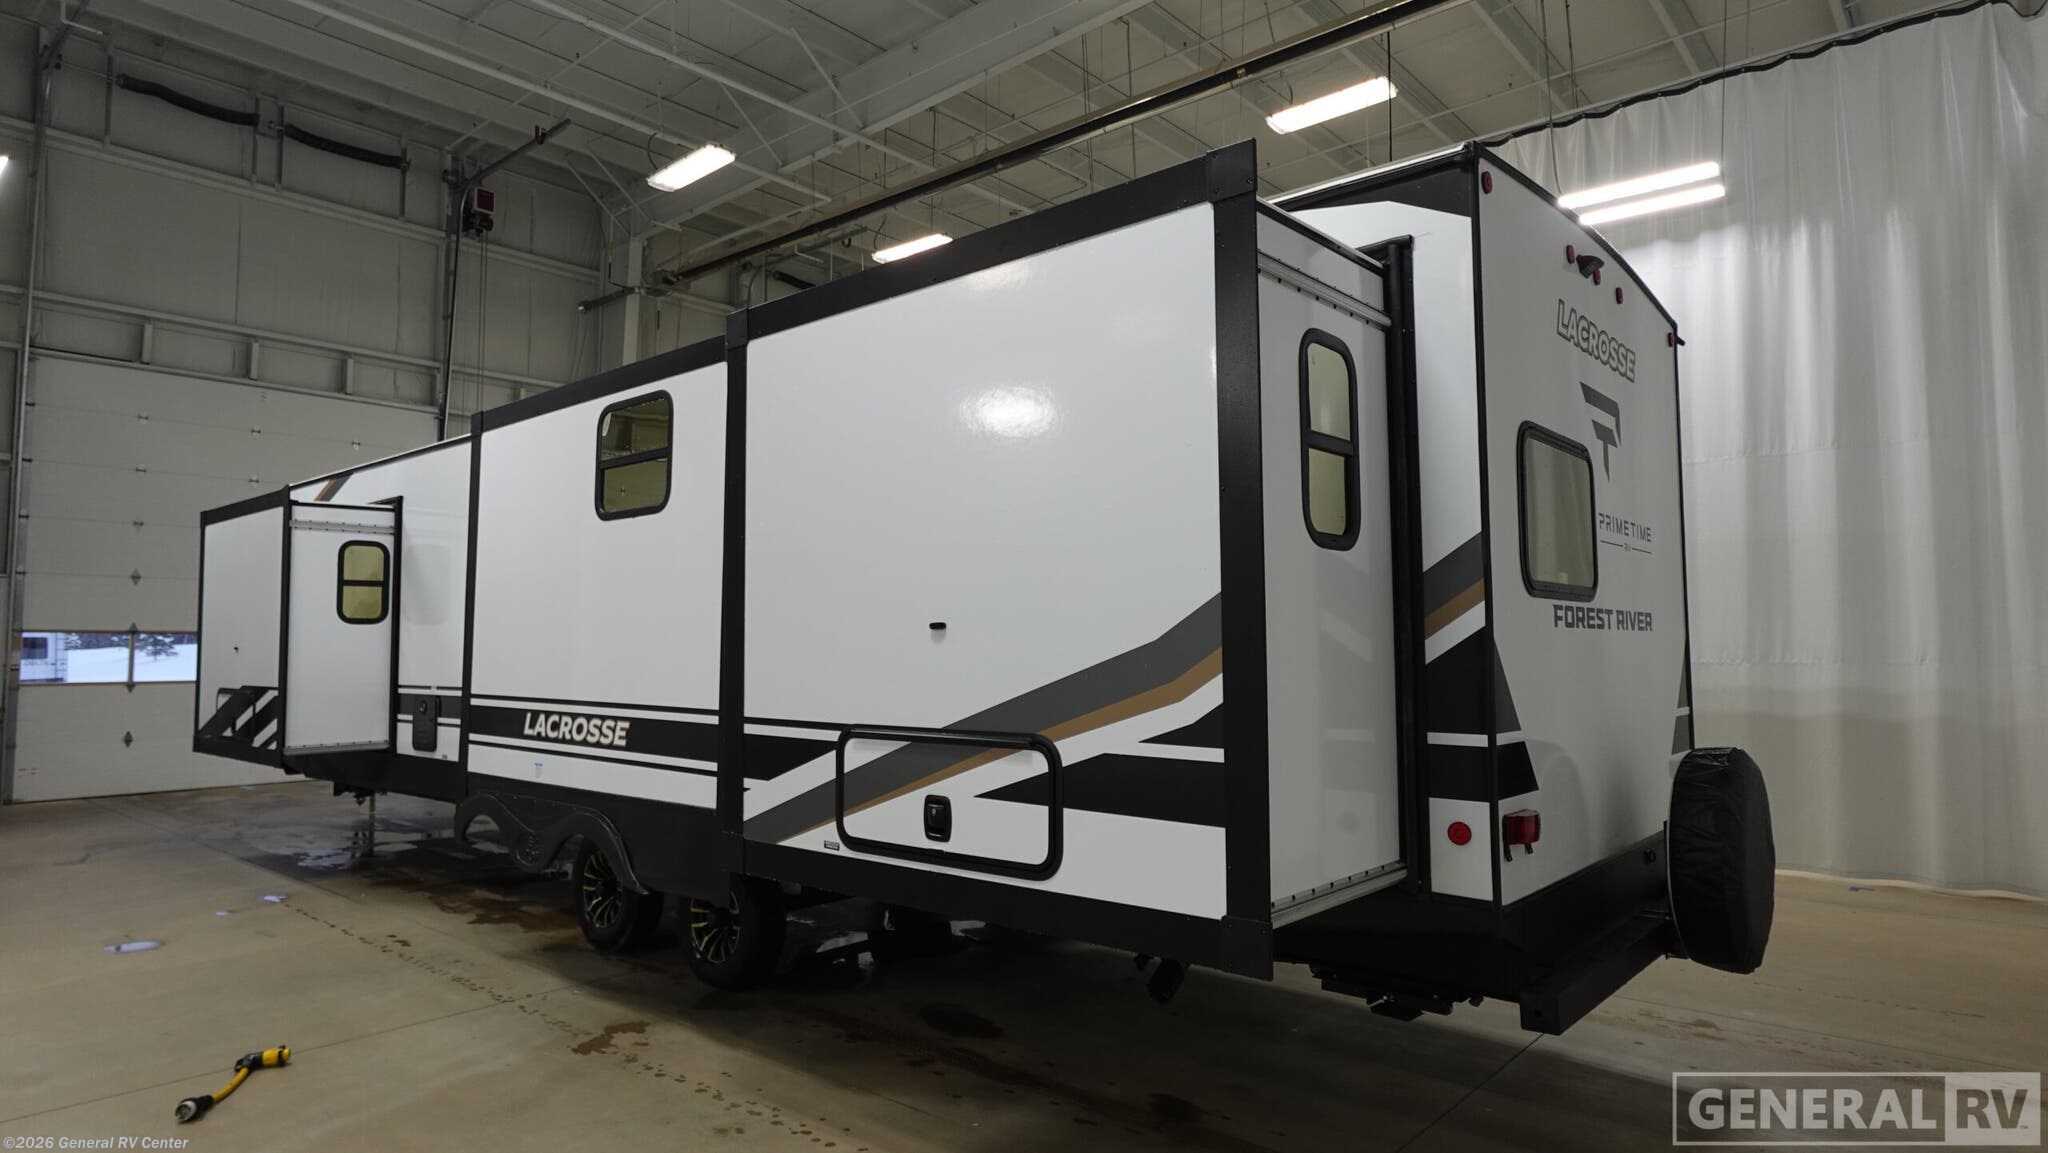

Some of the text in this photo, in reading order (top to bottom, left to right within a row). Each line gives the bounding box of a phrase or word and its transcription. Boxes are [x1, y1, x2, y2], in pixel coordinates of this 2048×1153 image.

[1556, 299, 1636, 383] LACROSSE
[1552, 604, 1653, 632] FOREST RIVER
[523, 712, 630, 747] LACROSSE
